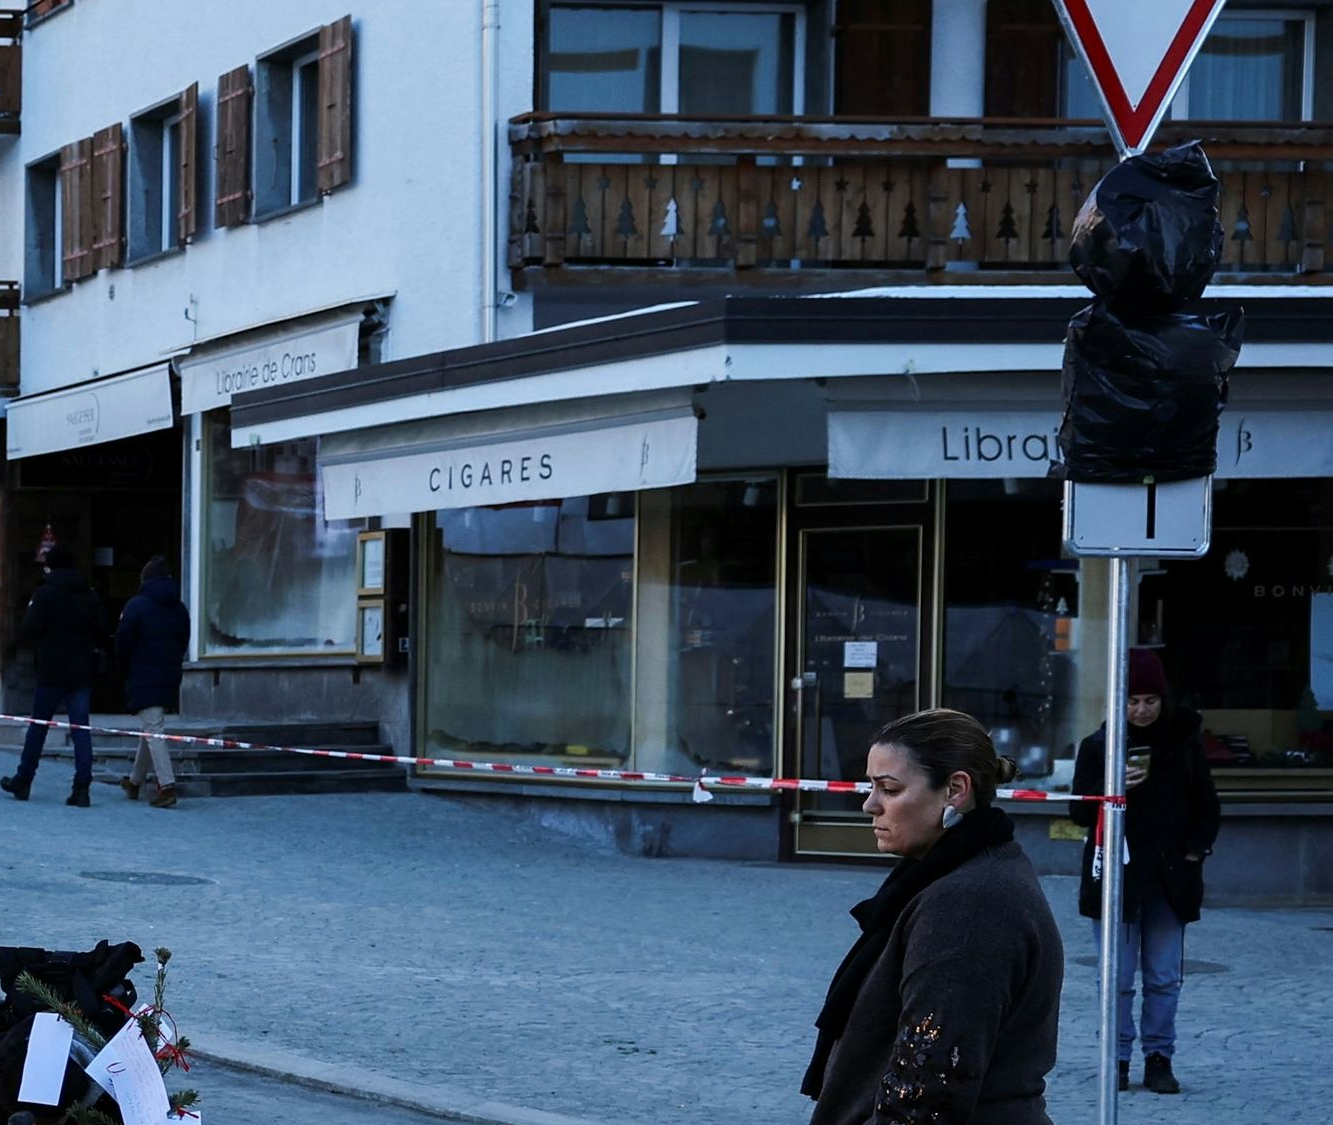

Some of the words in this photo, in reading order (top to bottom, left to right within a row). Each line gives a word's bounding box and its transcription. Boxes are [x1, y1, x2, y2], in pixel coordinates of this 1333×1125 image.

[216, 365, 259, 395] Librairie
[262, 359, 278, 383] de
[282, 352, 317, 379] Crans
[428, 453, 554, 492] CIGARES
